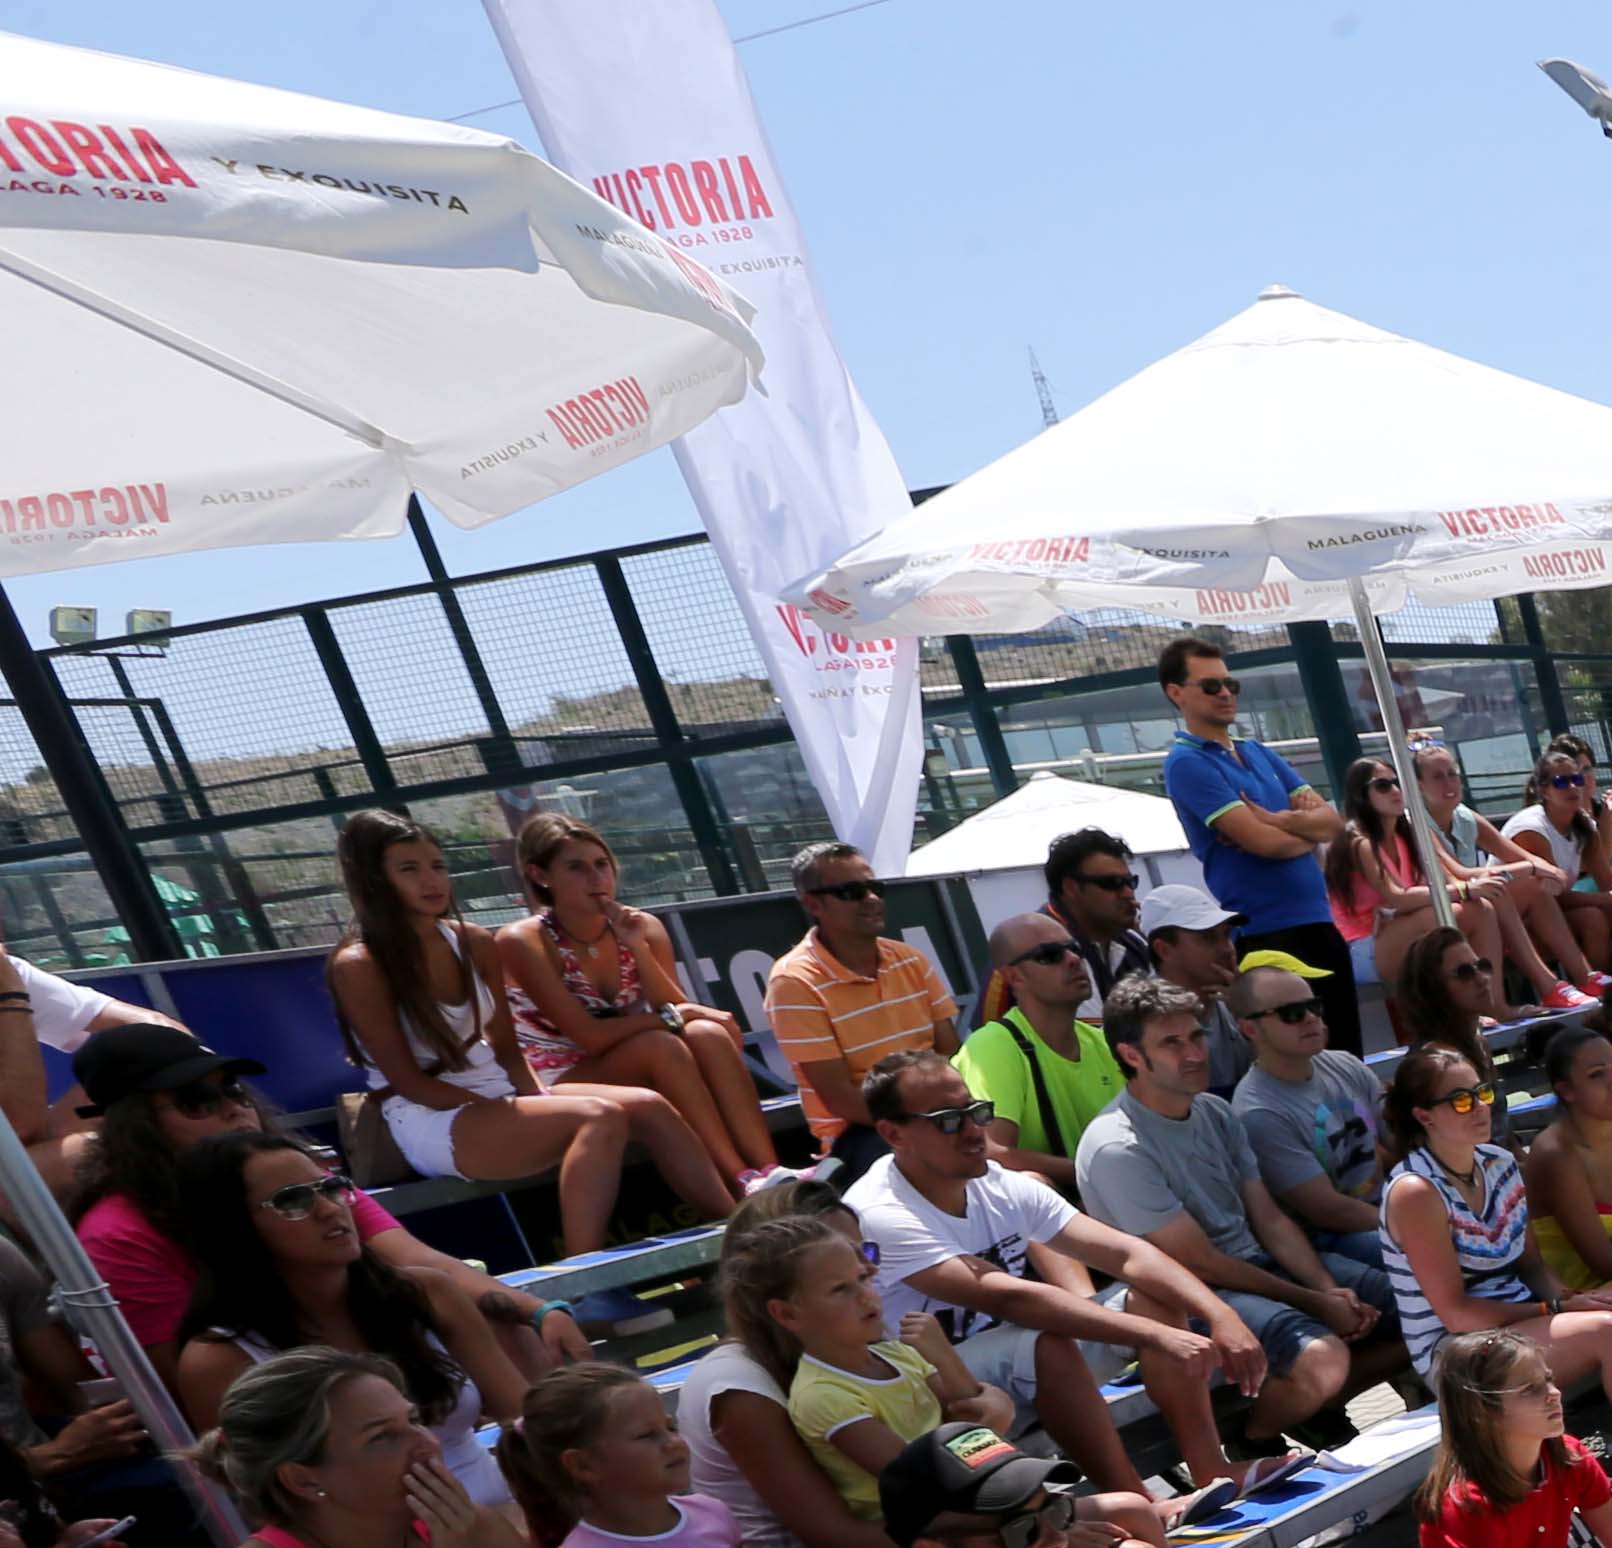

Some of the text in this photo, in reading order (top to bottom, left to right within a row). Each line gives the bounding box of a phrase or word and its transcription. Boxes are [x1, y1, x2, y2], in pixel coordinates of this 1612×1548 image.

[97, 185, 169, 204] 1928
[256, 163, 470, 215] EXQUISITA
[711, 226, 754, 245] 1928
[719, 255, 804, 276] EXQUISITA
[1438, 501, 1568, 538] VICTORIA
[970, 536, 1091, 564] VICTORIA
